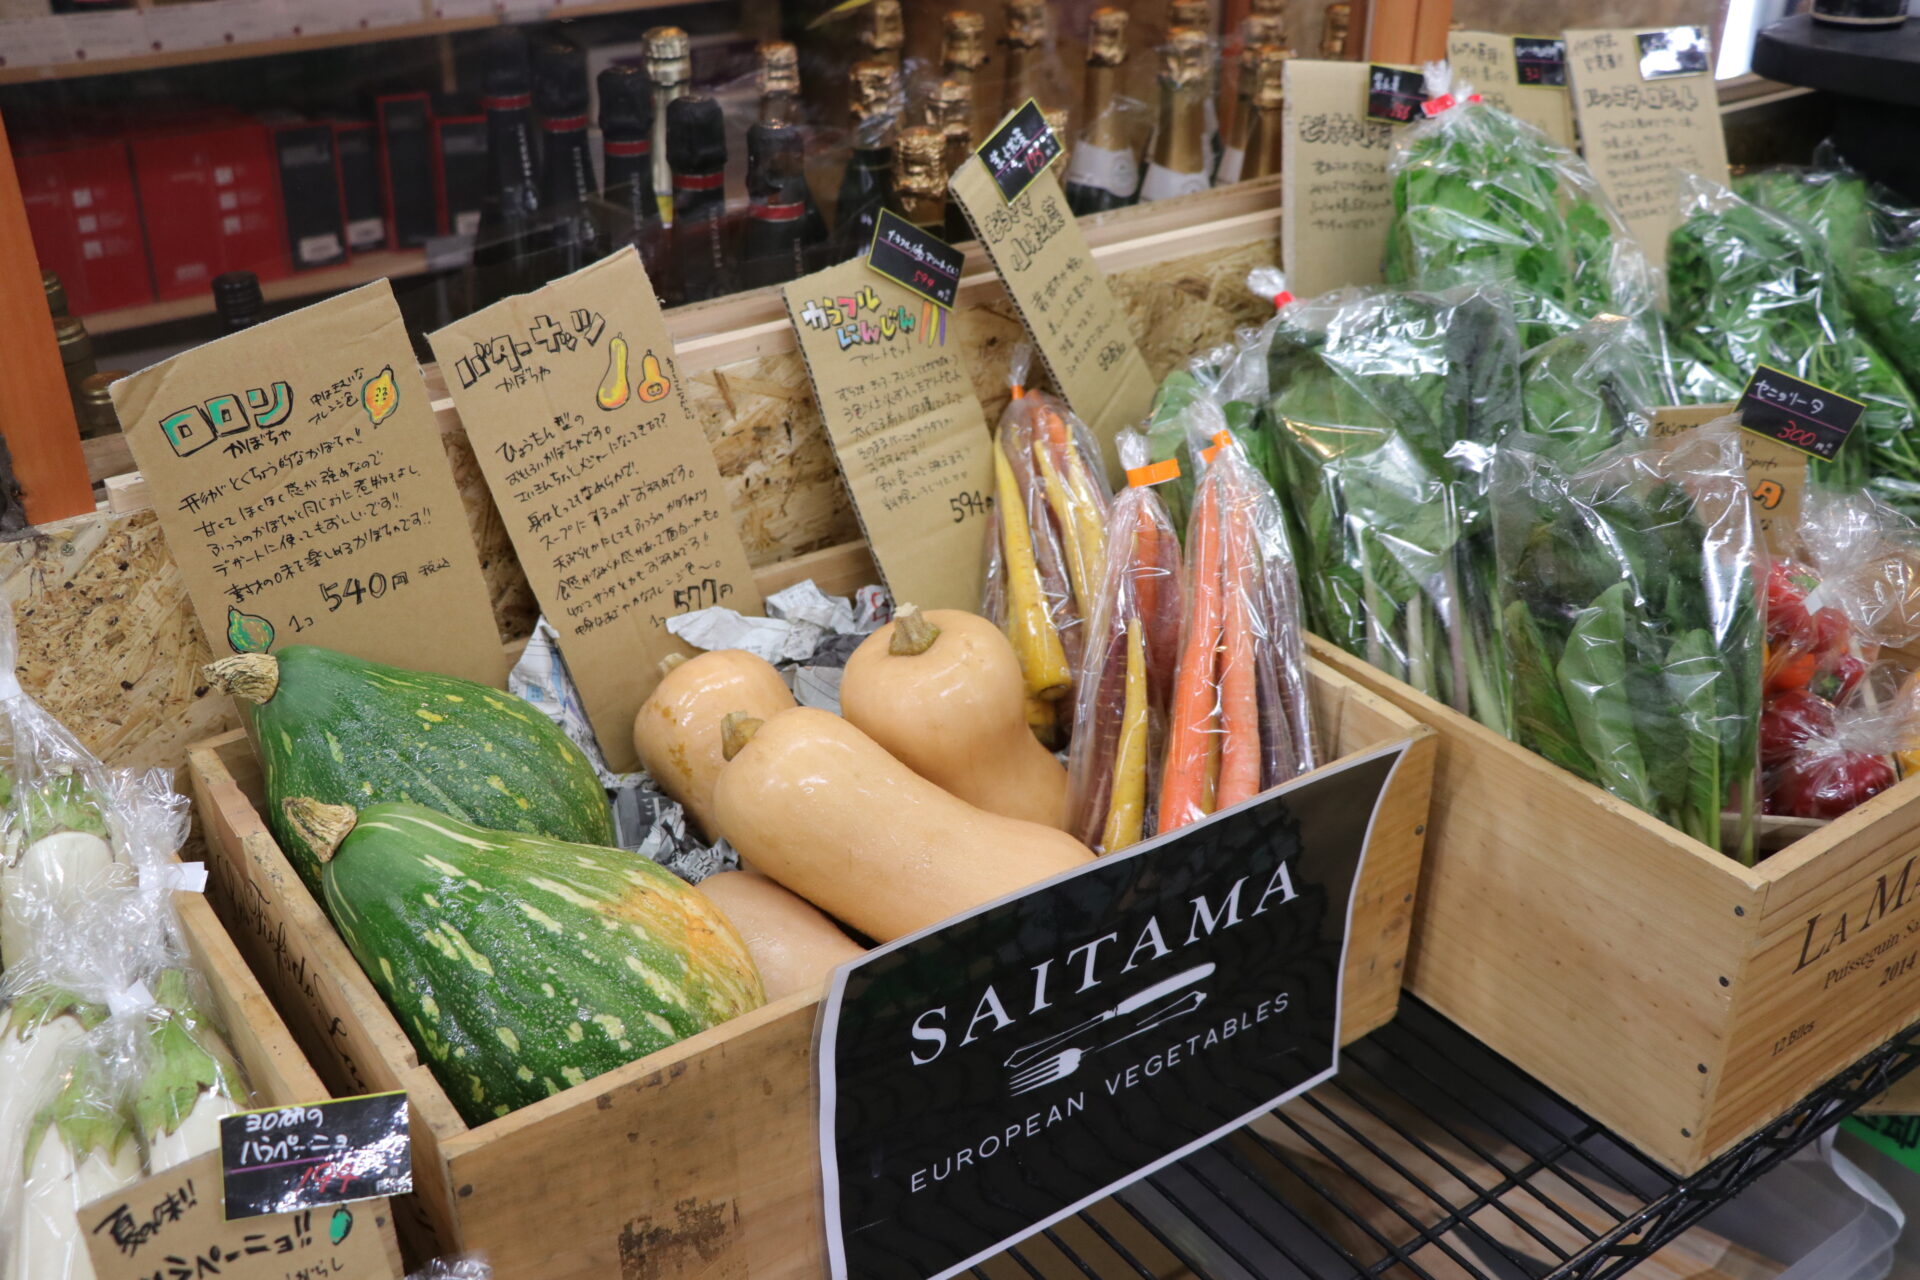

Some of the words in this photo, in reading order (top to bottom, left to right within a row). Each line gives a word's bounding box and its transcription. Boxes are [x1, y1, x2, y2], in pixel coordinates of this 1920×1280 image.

[800, 285, 881, 331] カラフル
[836, 306, 916, 351] にんじん
[495, 364, 551, 393] かぼちゃ
[1754, 380, 1826, 415] セニョリータ
[158, 381, 294, 458] ロロン
[307, 391, 359, 426] オレンジ色
[223, 428, 292, 460] かぼちゃ
[1777, 420, 1817, 446] 300
[910, 859, 1299, 1066] SAITAMA
[1792, 911, 1847, 975] LA
[1878, 950, 1918, 988] 2014
[910, 1091, 1086, 1193] EUROPEAN
[1105, 992, 1290, 1096] VEGETABLES
[241, 1134, 348, 1164] ハラペーニョ
[92, 1179, 199, 1258] 夏の味!!
